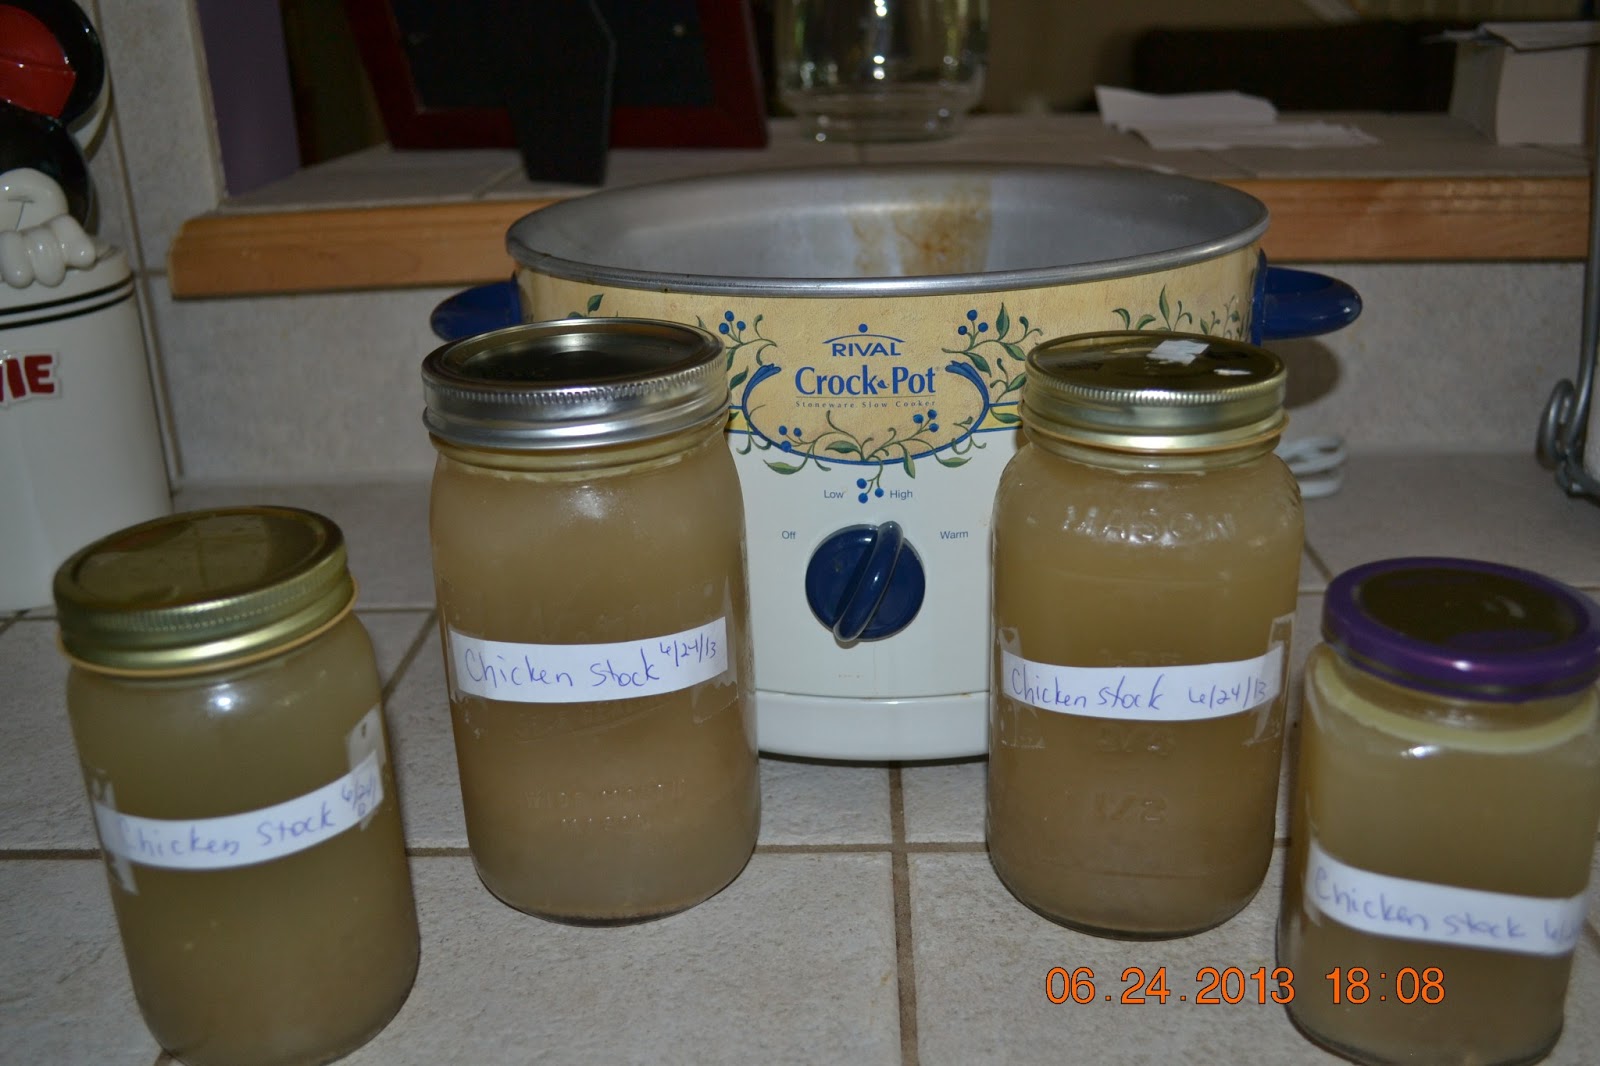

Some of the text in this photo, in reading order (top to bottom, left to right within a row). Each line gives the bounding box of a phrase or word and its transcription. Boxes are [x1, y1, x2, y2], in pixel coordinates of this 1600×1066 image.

[832, 343, 902, 357] RIVAL
[0, 354, 55, 402] IE
[795, 399, 937, 409] Stoneware Slow Cooker
[824, 490, 844, 499] Low
[889, 489, 913, 500] High
[782, 530, 796, 540] Off
[940, 530, 969, 540] Warm
[465, 648, 574, 688] Chicken
[1011, 664, 1087, 709] Chicken
[1314, 865, 1430, 932] Chicken
